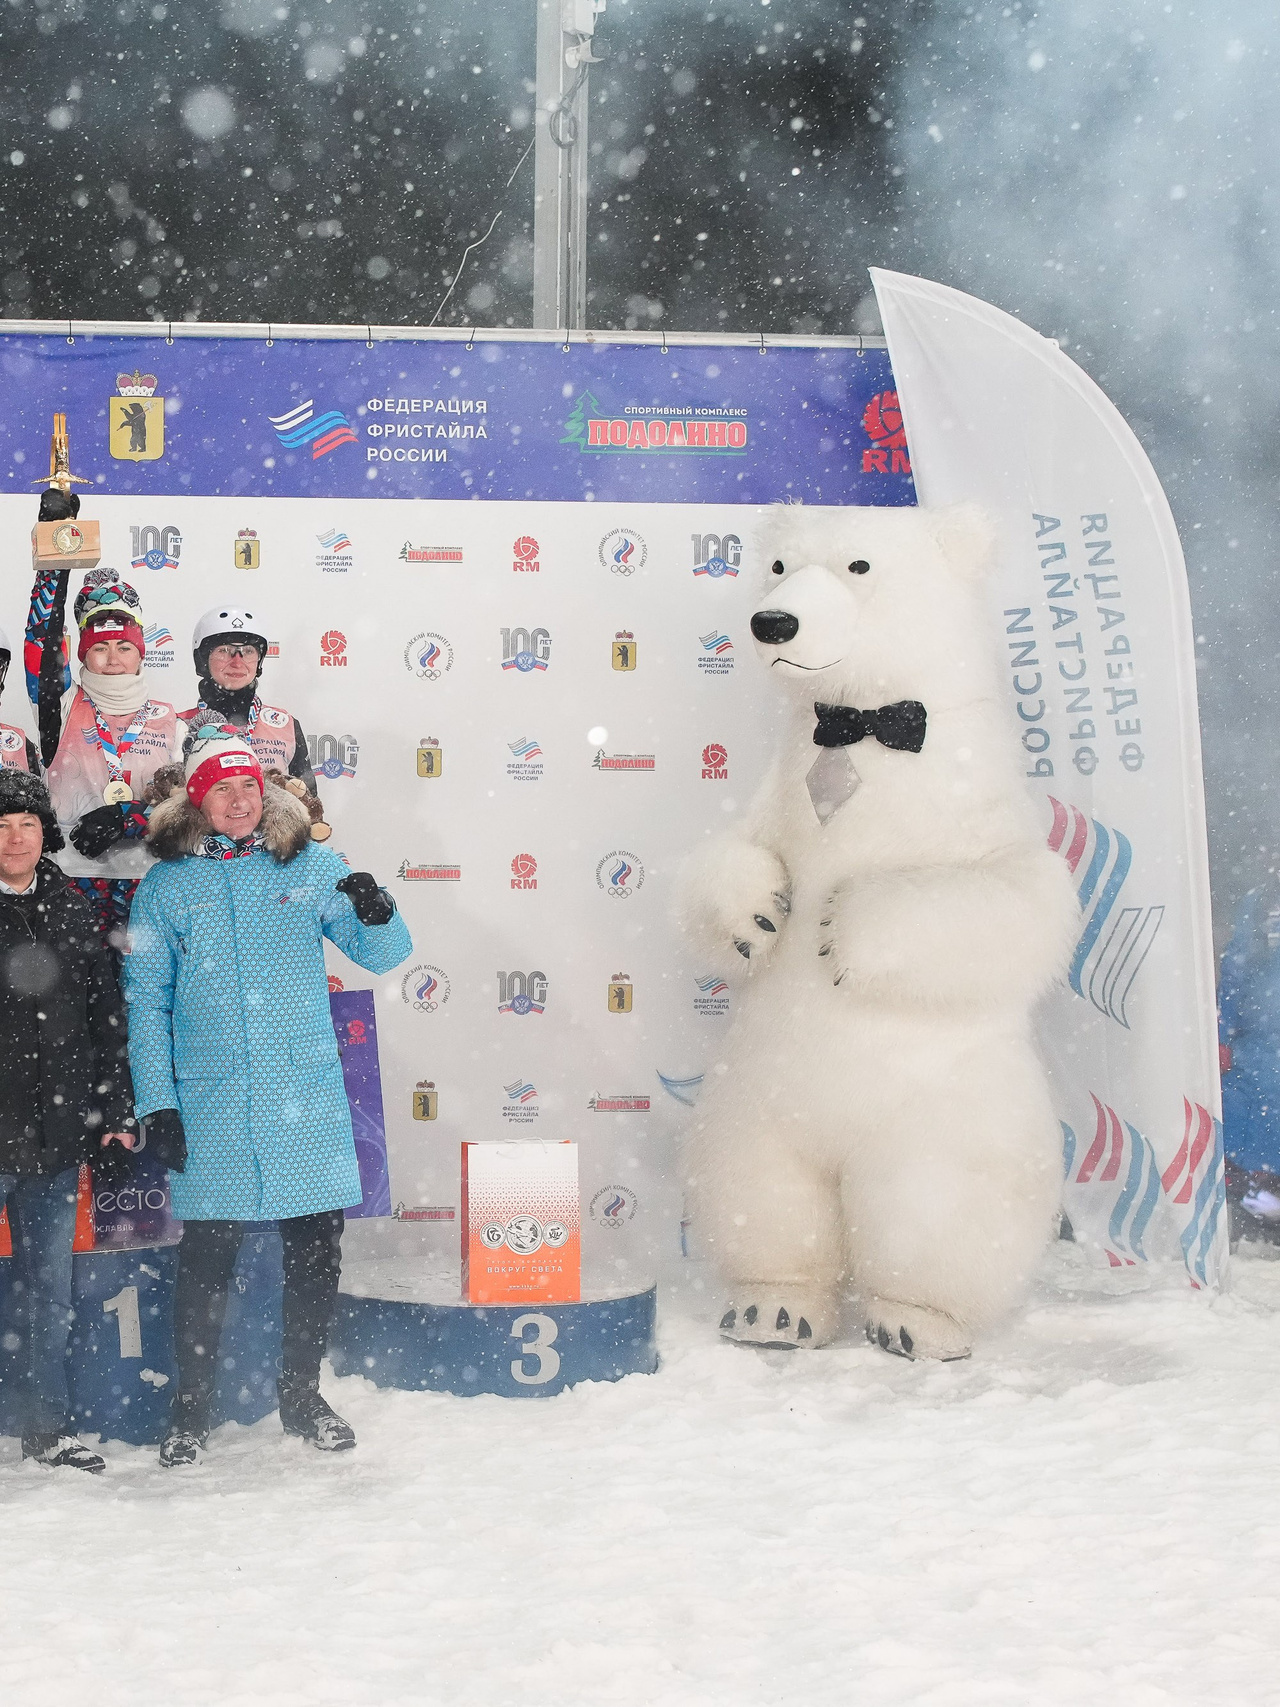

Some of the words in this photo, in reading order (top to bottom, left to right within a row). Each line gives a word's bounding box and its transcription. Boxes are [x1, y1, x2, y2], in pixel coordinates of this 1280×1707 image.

[366, 398, 488, 416] ФЕДЕРАЦИЯ
[624, 405, 693, 415] СПОРТИВНЫЙ
[695, 407, 748, 416] КОМПЛЕКС
[366, 421, 488, 439] ФРИСТАЙЛА
[587, 419, 748, 449] ПОДОЛИНО
[366, 448, 448, 462] РОССИИ
[862, 450, 915, 474] RM
[513, 561, 540, 572] RM
[320, 656, 348, 666] RM
[128, 747, 151, 755] ССИИ
[702, 768, 728, 779] RM
[511, 879, 538, 889] RM
[531, 1265, 563, 1273] СВЕТА
[102, 1286, 143, 1359] 1
[509, 1313, 562, 1386] 3
